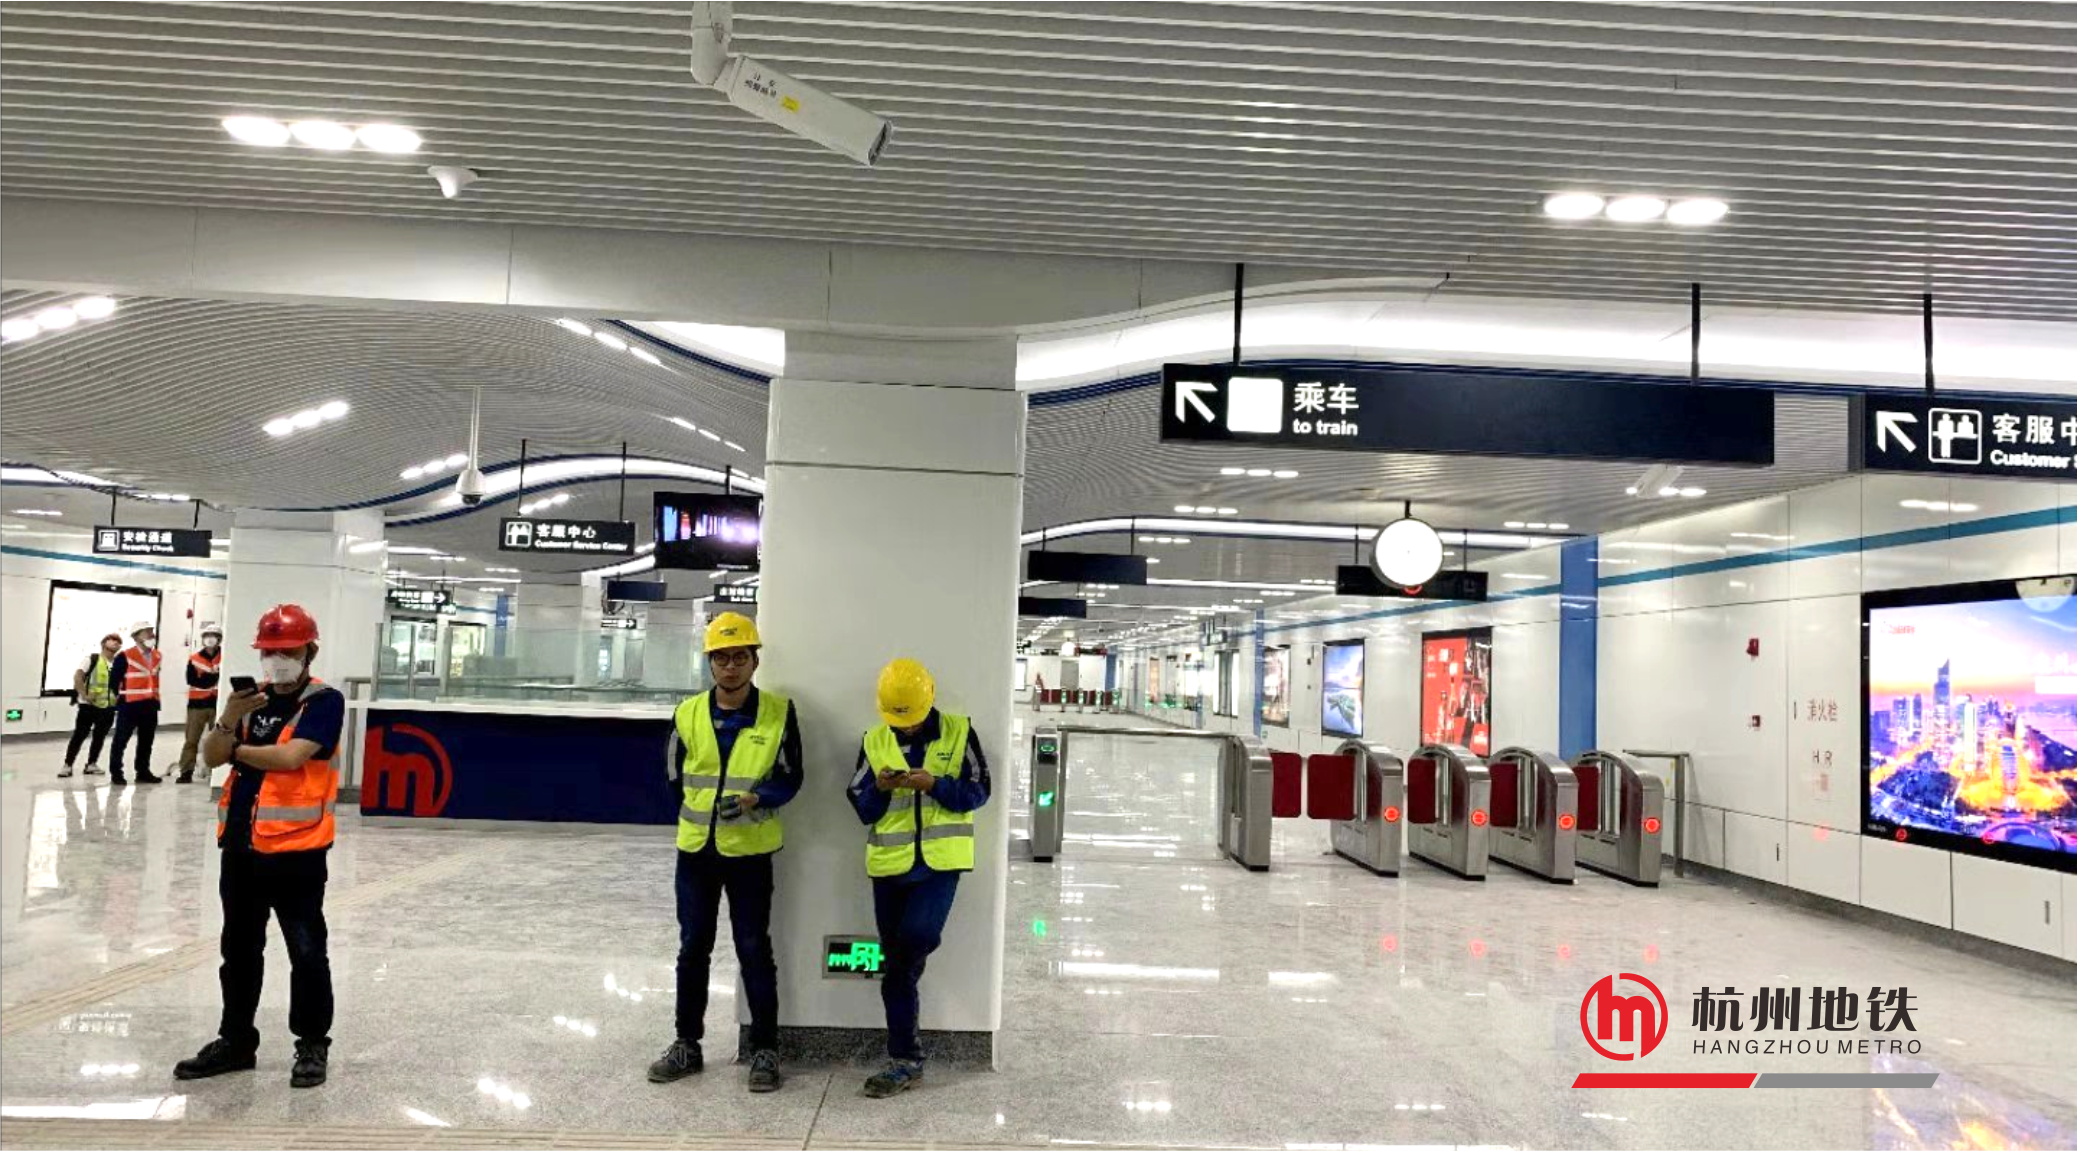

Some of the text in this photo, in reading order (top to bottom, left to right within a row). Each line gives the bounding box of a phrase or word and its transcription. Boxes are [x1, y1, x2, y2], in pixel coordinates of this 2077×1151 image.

[1293, 382, 1359, 415] 乘车
[1293, 418, 1358, 436] to train
[1990, 449, 2070, 469] Customer
[535, 523, 597, 539] 客服中心
[534, 539, 572, 549] Customer
